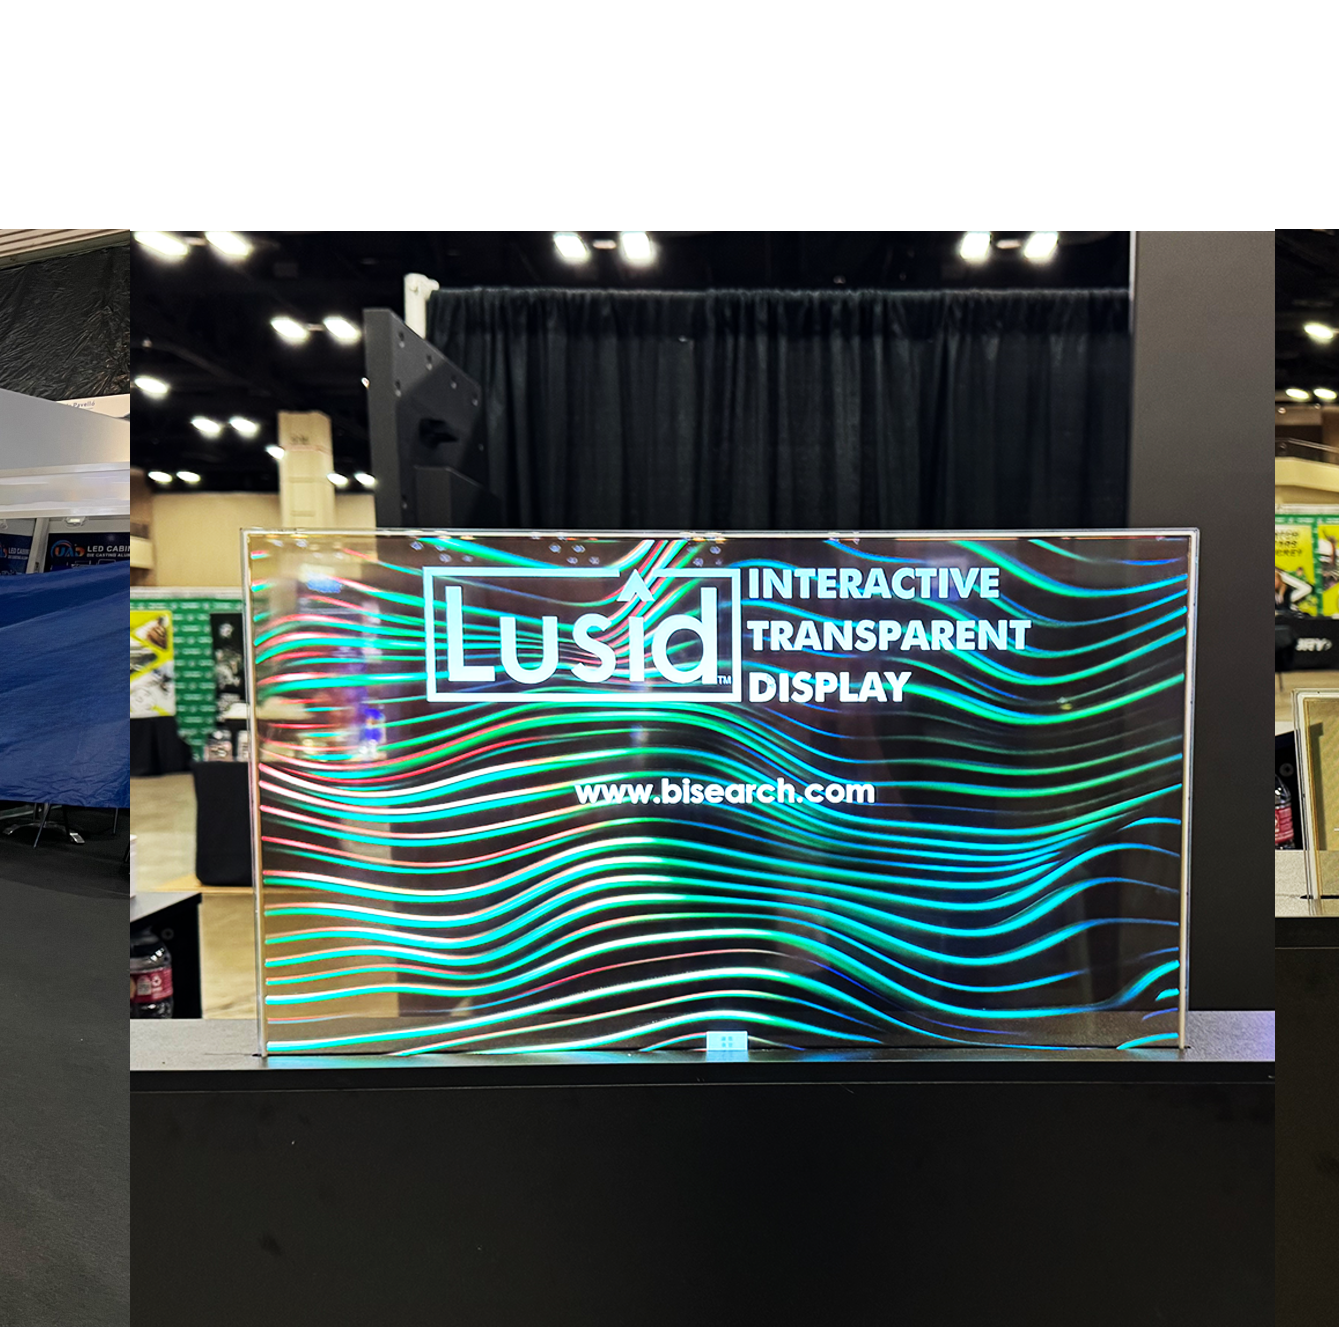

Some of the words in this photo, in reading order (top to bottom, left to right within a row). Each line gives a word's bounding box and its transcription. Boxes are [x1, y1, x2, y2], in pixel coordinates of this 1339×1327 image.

[748, 567, 1000, 600] INTERACTIVE
[445, 568, 718, 685] Lusid
[746, 619, 1032, 651] TRANSPARENT
[748, 671, 912, 703] DISPLAY
[574, 777, 876, 805] www.bisearch.com
